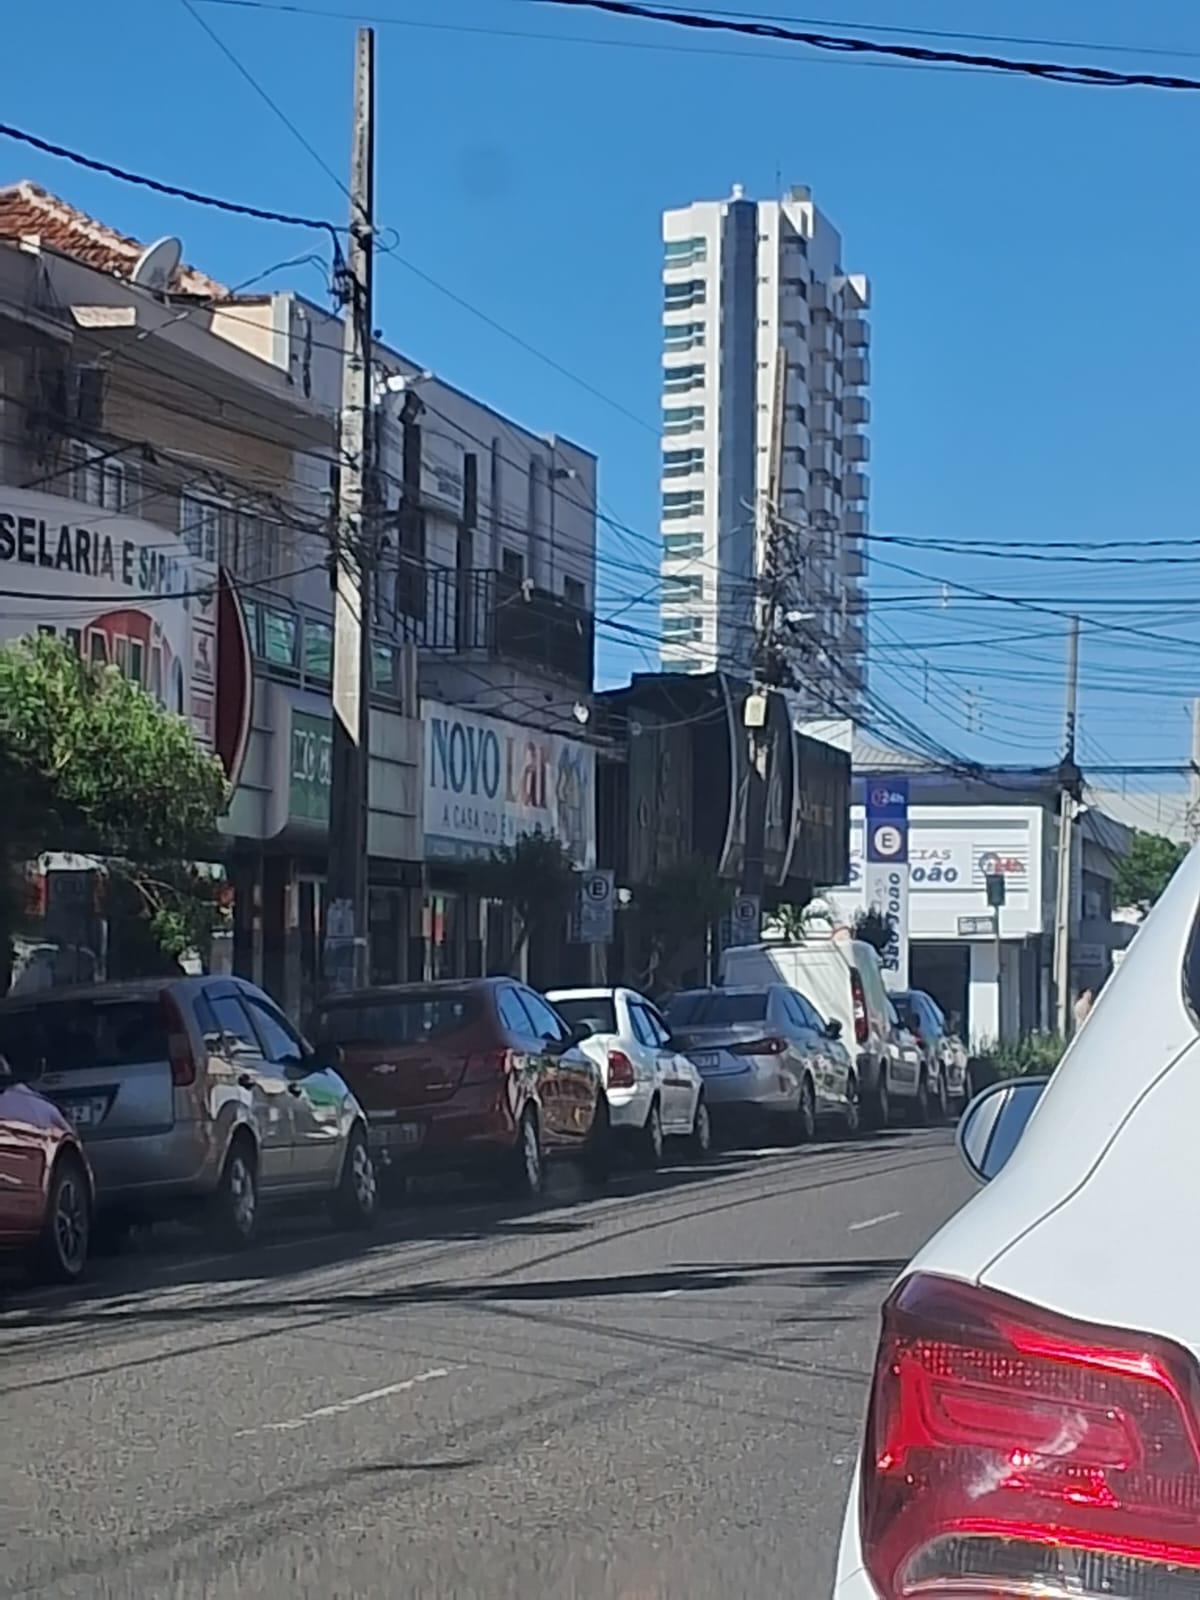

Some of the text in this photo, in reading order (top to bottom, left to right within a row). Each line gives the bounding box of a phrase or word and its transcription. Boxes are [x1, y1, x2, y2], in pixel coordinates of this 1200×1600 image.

[122, 540, 135, 587] E
[430, 718, 500, 799] NOVO
[881, 833, 893, 849] E
[908, 861, 959, 882] oão
[592, 882, 603, 896] E
